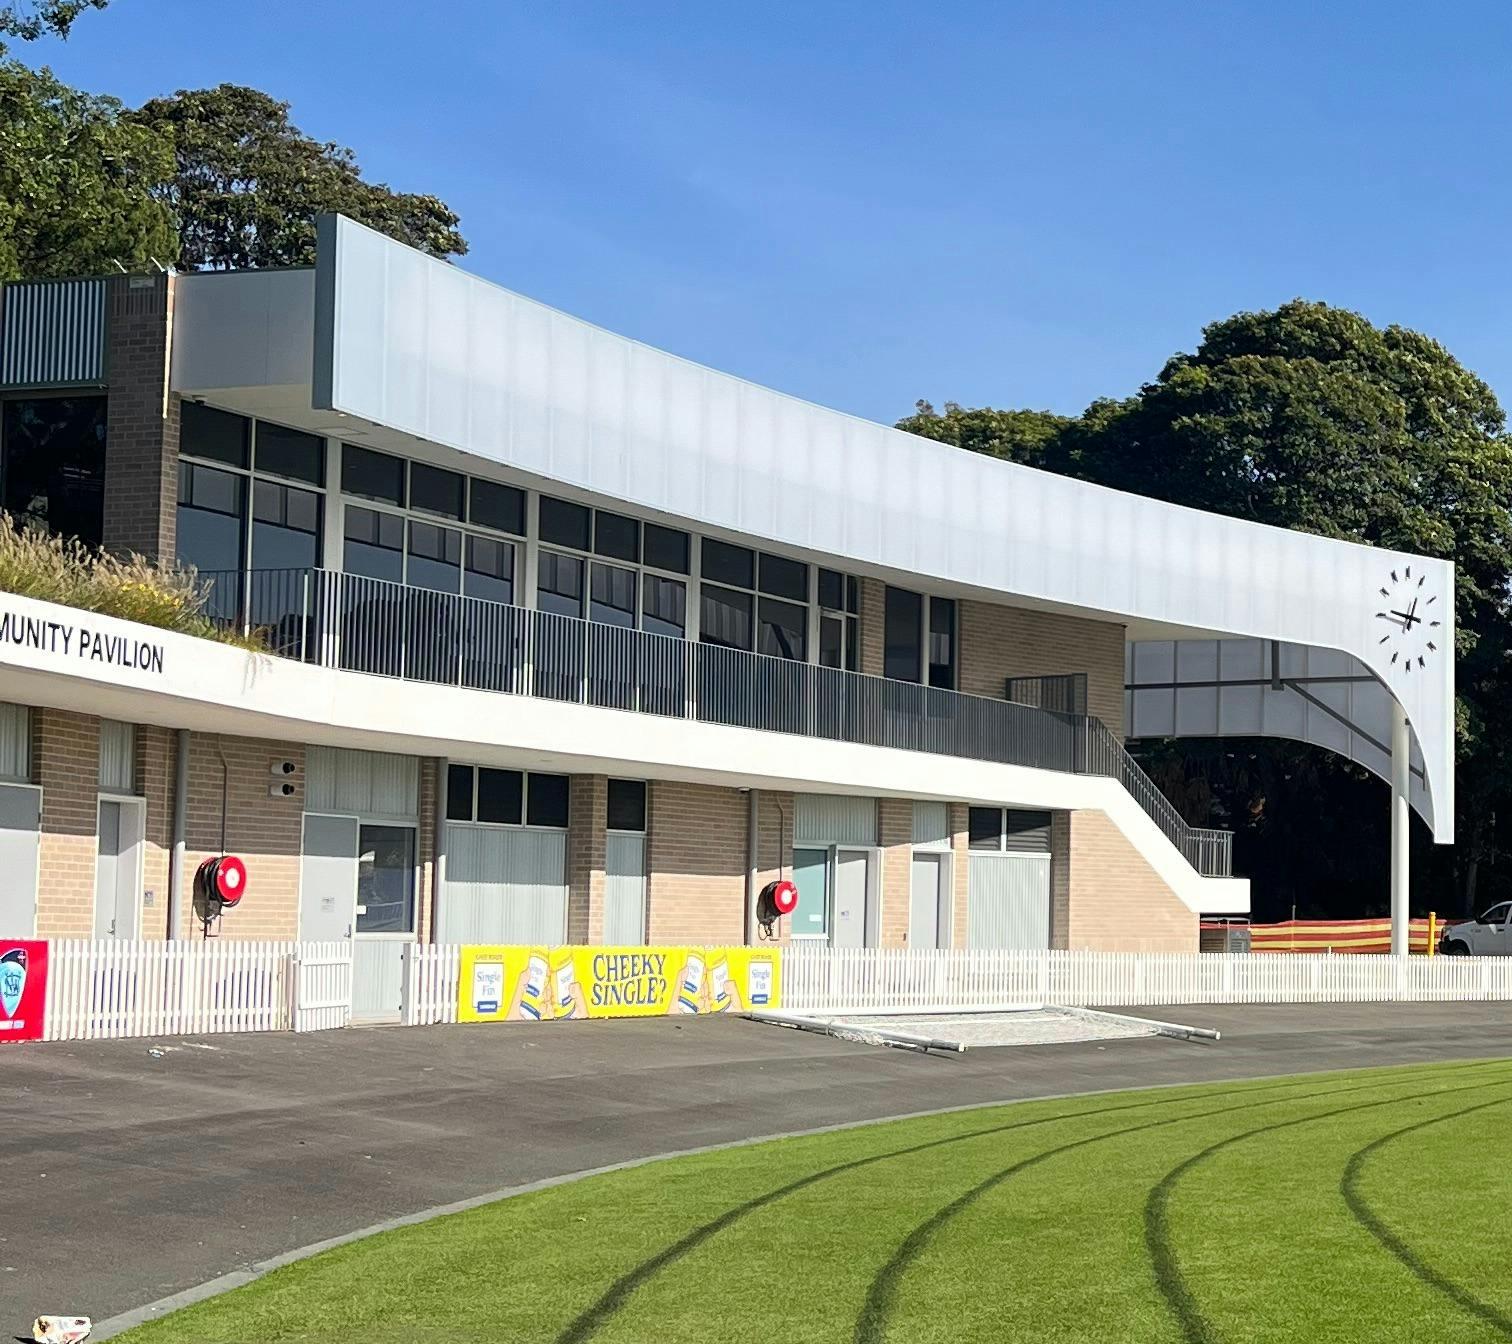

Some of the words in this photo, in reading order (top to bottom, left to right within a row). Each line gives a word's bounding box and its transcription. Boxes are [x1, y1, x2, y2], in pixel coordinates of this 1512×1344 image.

[79, 629, 164, 674] PAVILION
[593, 954, 666, 982] CHEEKY
[591, 977, 667, 1005] SINGLE?
